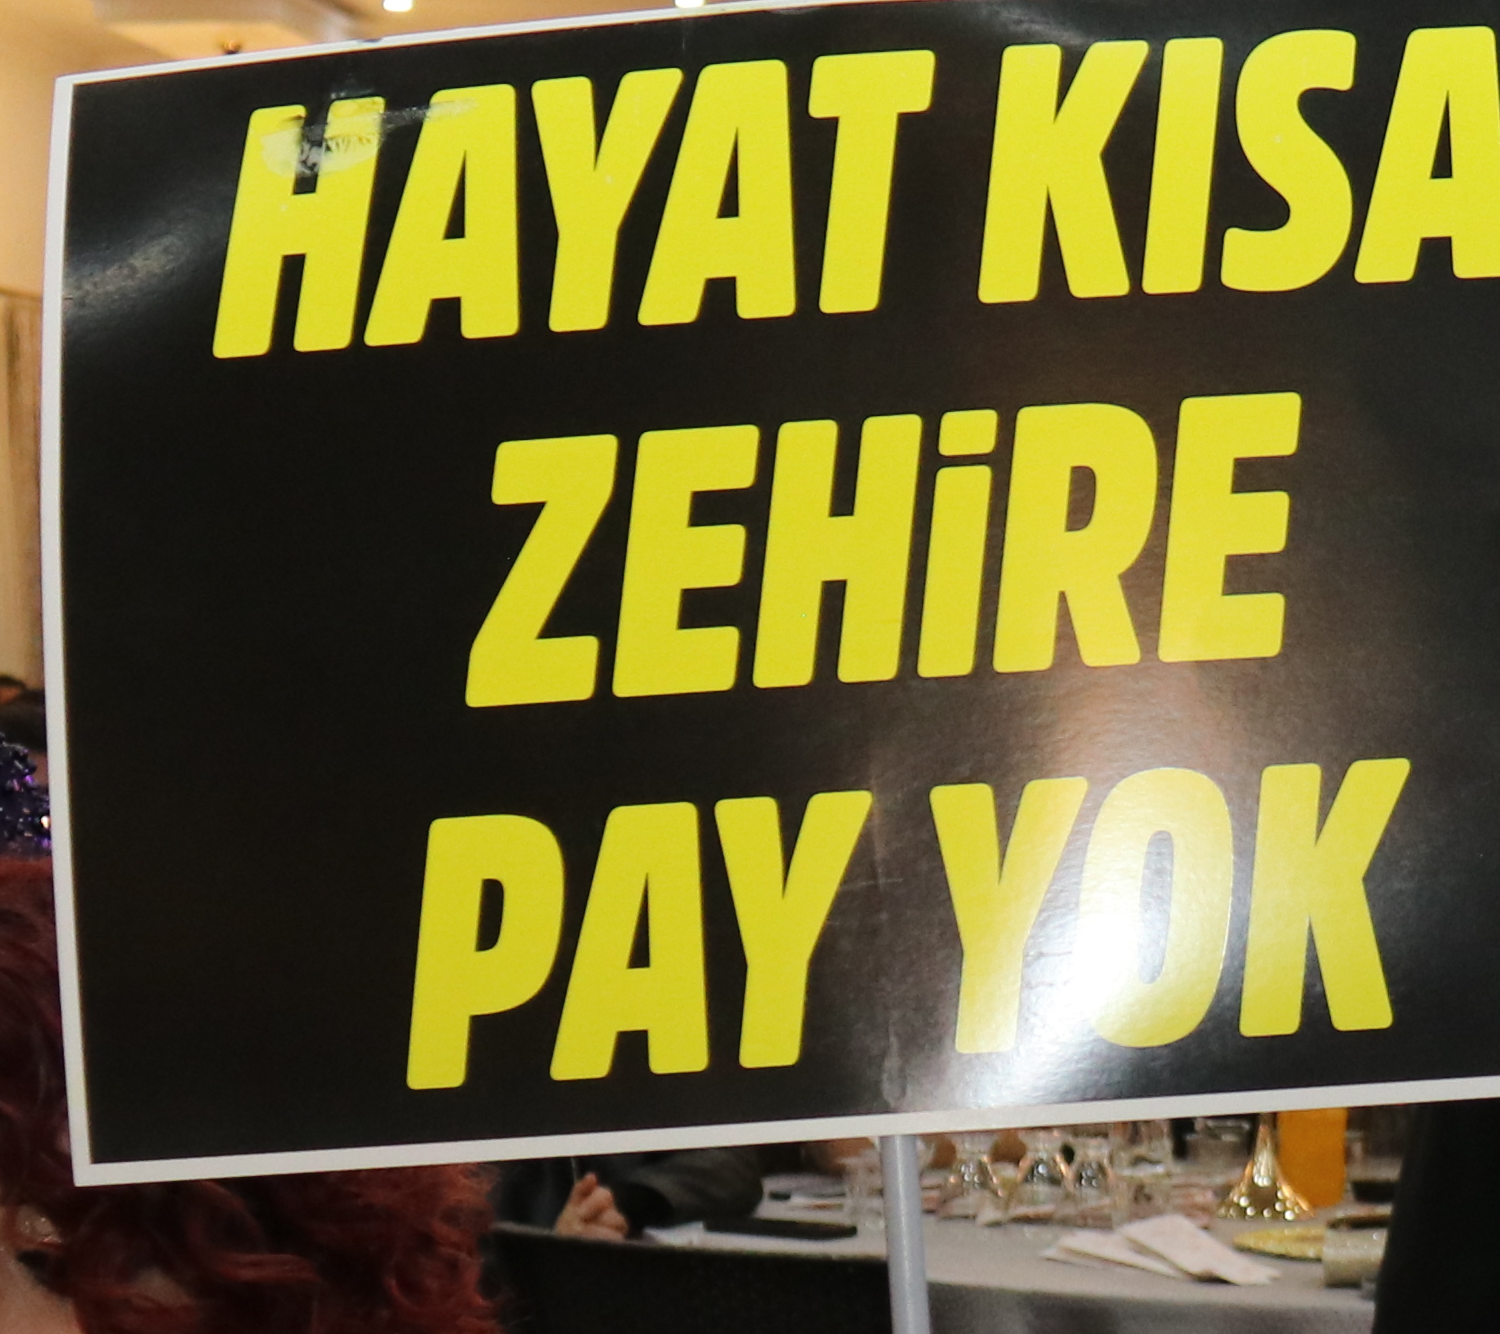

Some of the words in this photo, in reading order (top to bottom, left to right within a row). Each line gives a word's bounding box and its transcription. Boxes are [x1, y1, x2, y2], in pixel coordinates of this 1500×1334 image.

[212, 50, 936, 359] HAYAT
[406, 790, 875, 1090] PAY
[929, 757, 1411, 1055] YOK
